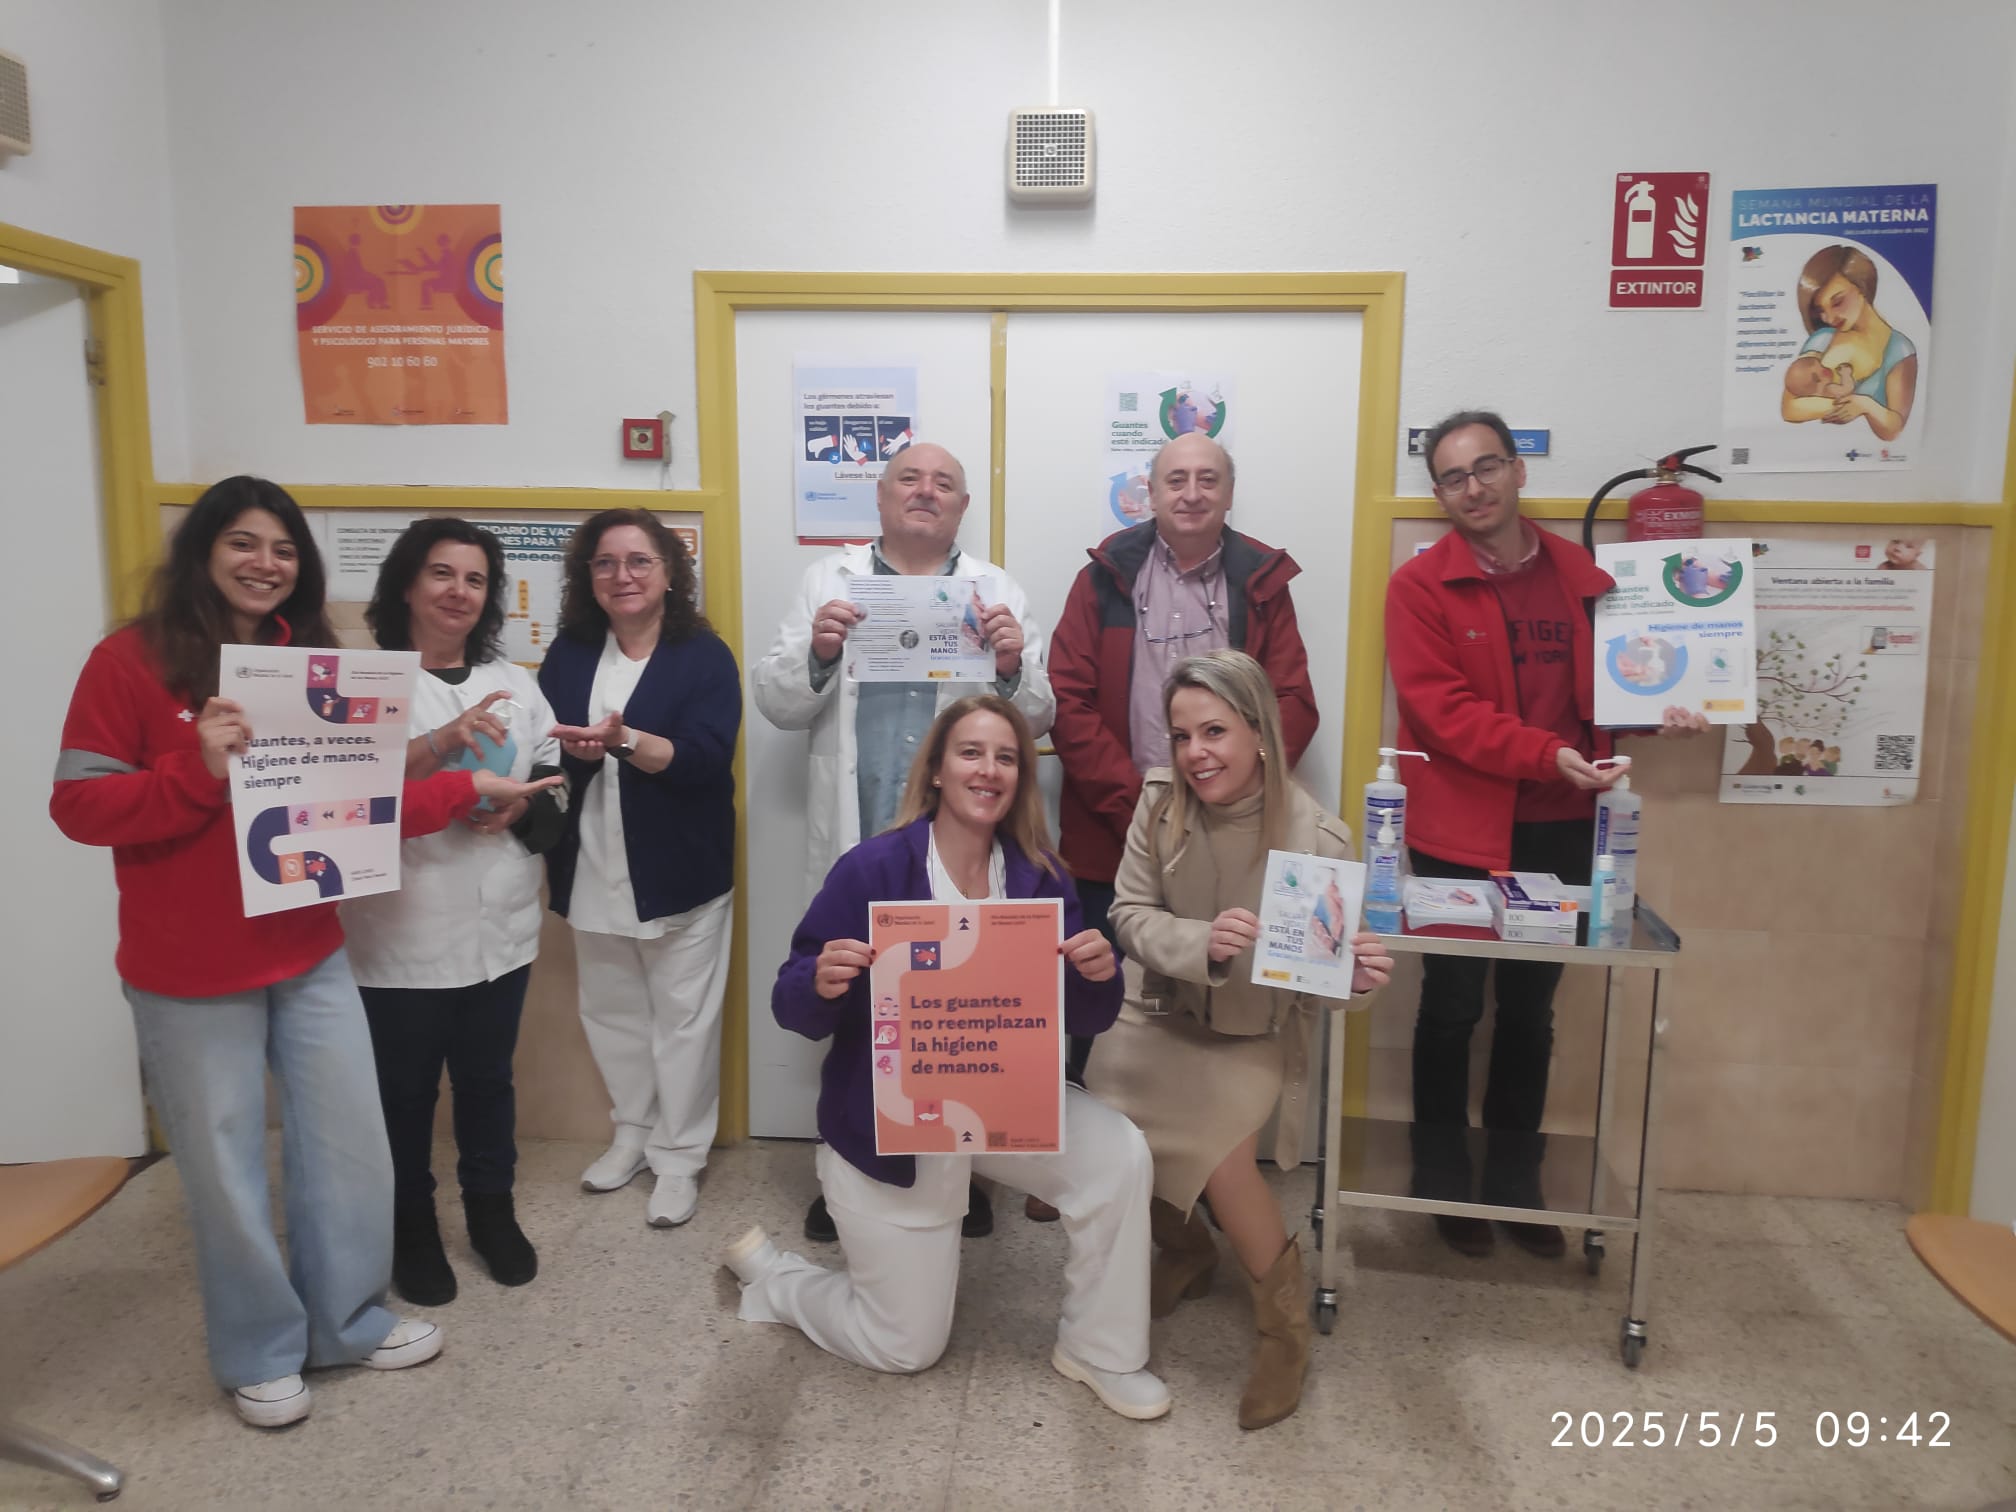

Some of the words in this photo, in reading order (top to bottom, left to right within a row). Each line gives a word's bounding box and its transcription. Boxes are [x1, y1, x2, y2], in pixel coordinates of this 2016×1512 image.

[1740, 199, 1802, 210] SEMANA
[1884, 195, 1905, 206] DE
[1911, 194, 1930, 205] LA
[1738, 211, 1839, 227] LACTANCIA
[1842, 208, 1930, 224] MATERNA
[1616, 281, 1697, 295] EXTINTOR
[1111, 421, 1148, 429] Guantes
[531, 527, 548, 536] DE
[523, 537, 557, 547] PARA
[1631, 600, 1675, 609] indicado
[1648, 623, 1688, 633] Higiene
[1707, 620, 1743, 629] manos
[1698, 630, 1743, 639] siempre
[245, 735, 310, 749] uantes,
[313, 737, 323, 746] a
[241, 753, 297, 772] Higiene
[300, 751, 320, 766] de
[323, 750, 380, 765] manos,
[243, 773, 303, 790] siempre
[1268, 941, 1303, 954] MANOS
[911, 996, 942, 1010] Los
[946, 995, 1022, 1013] guantes
[911, 1018, 932, 1030] no
[937, 1015, 1047, 1033] reemplazan
[911, 1037, 928, 1052] la
[931, 1036, 998, 1057] higiene
[911, 1058, 933, 1074] de
[937, 1061, 1005, 1075] manos.
